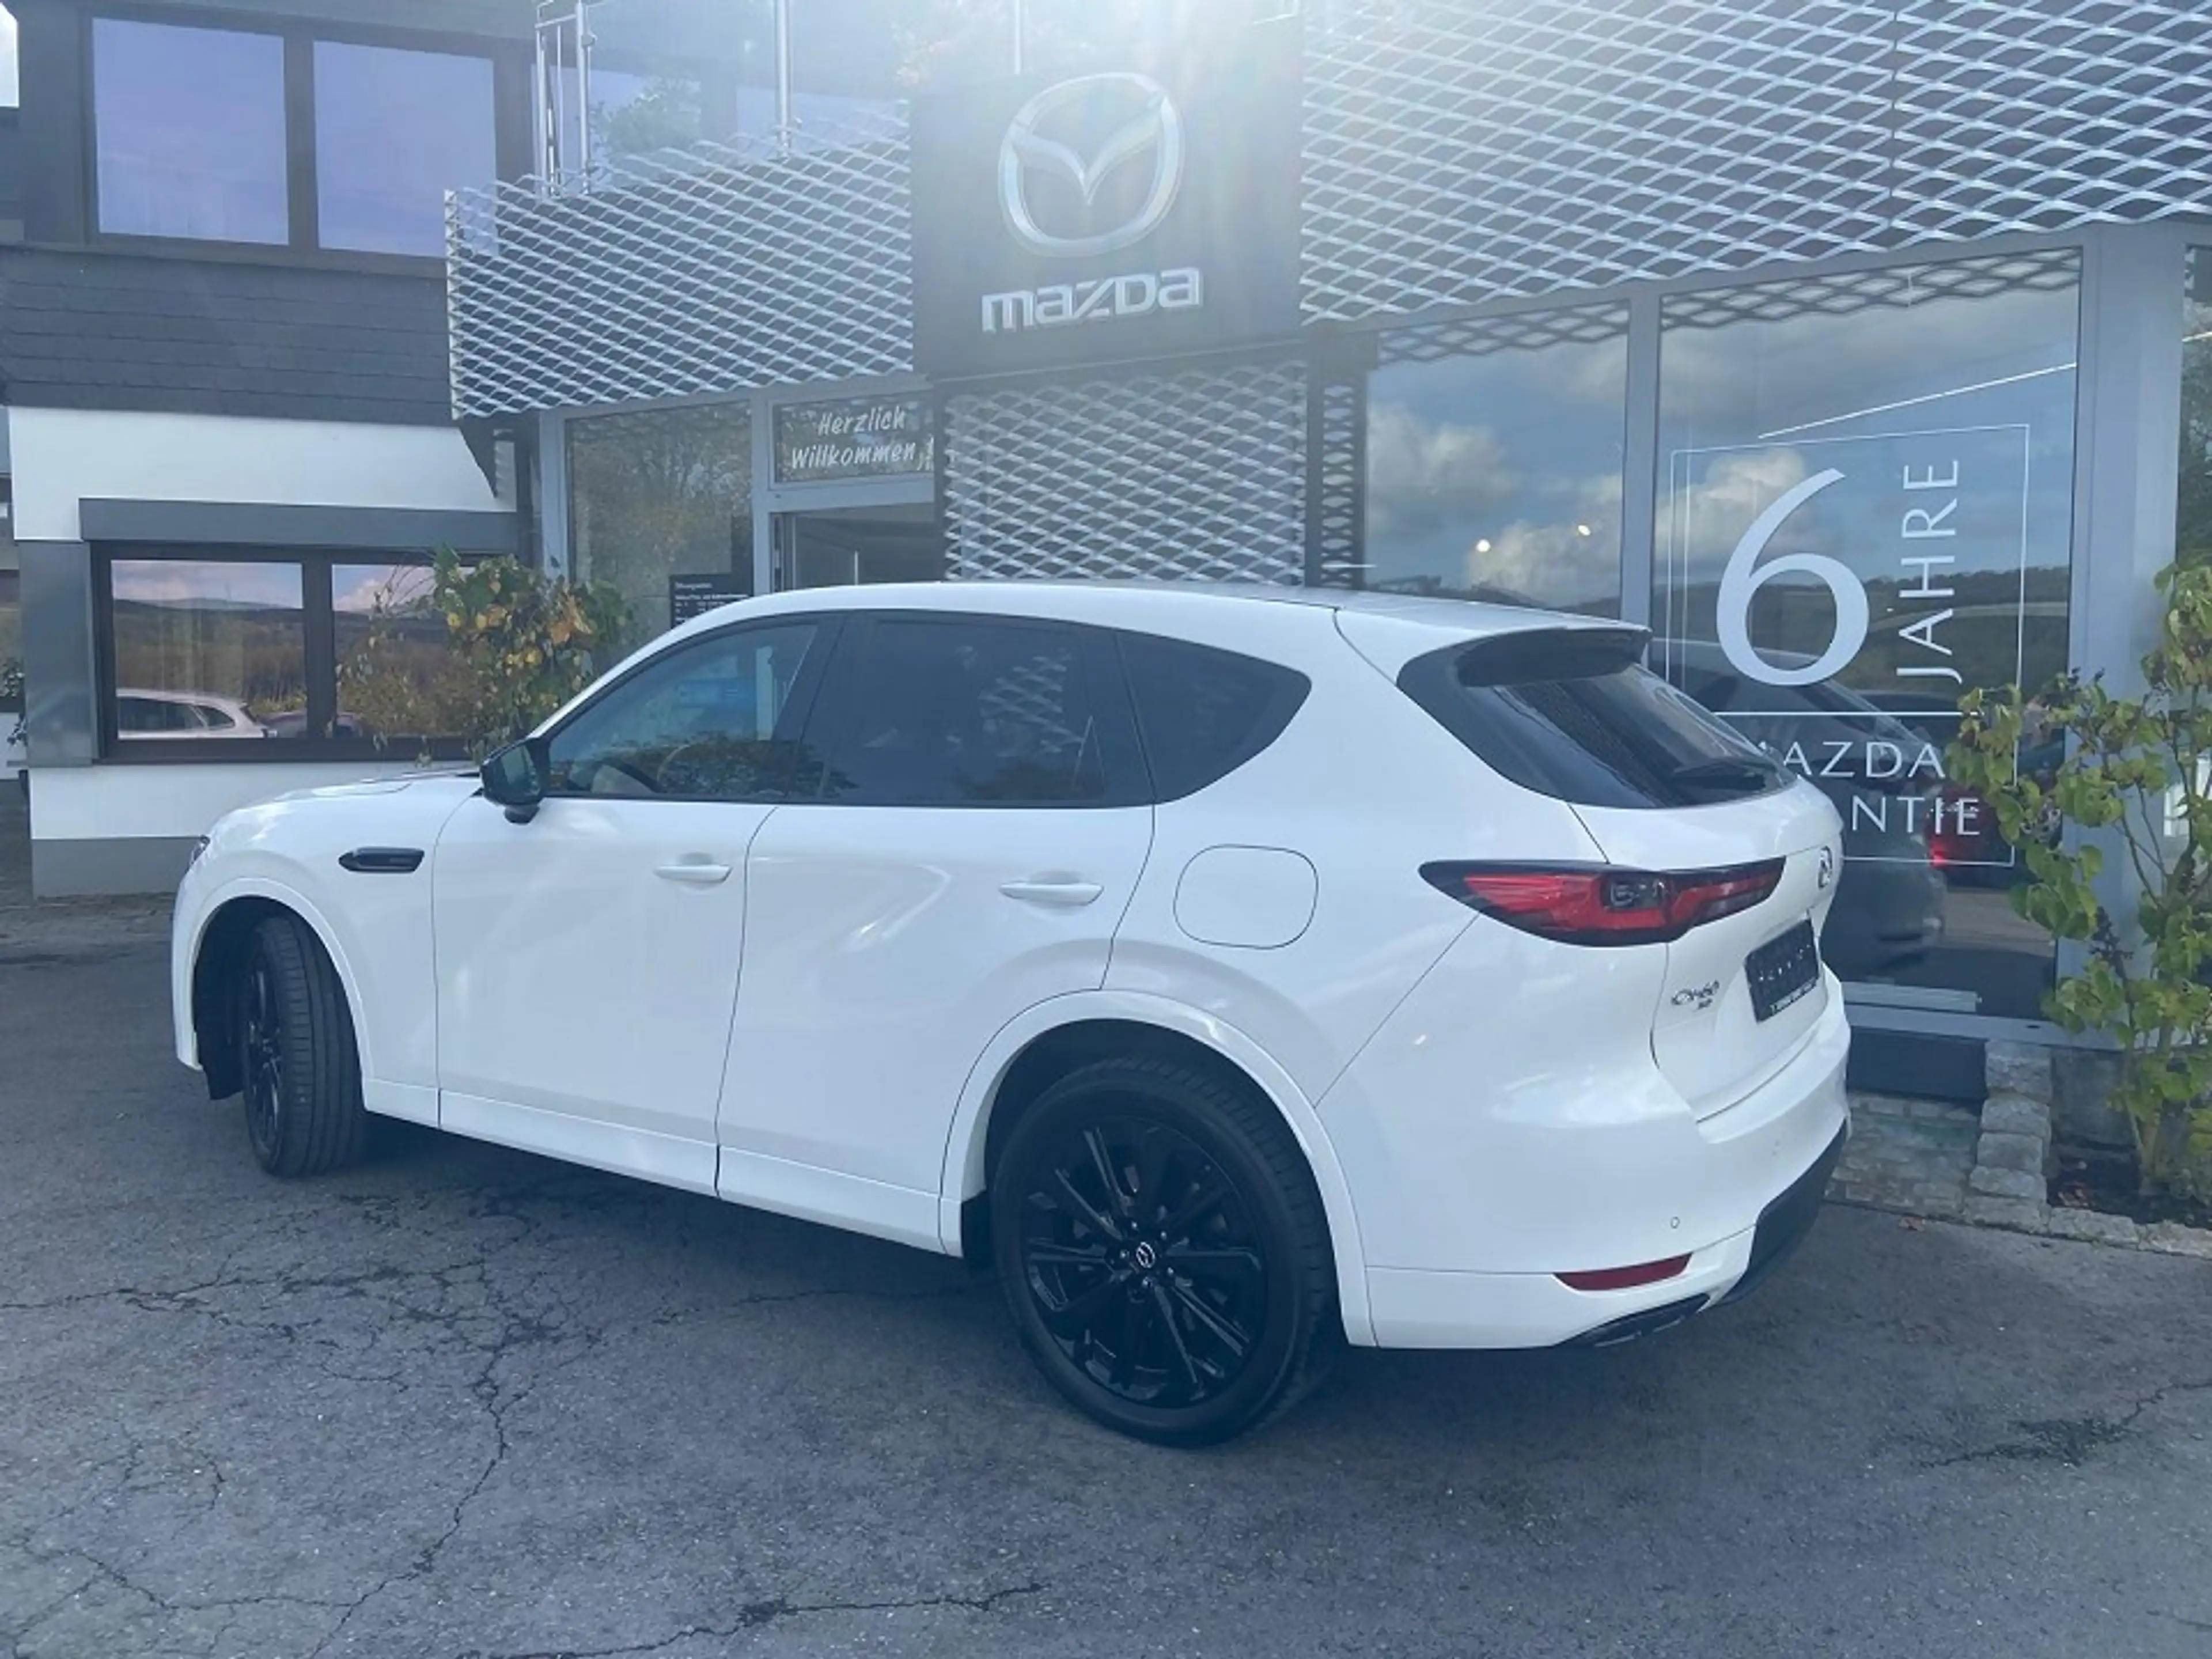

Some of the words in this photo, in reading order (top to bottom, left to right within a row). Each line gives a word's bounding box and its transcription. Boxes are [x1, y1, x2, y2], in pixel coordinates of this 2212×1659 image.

[818, 405, 906, 435] Herzlich
[791, 442, 916, 469] Willkommen
[1716, 467, 1870, 685] 6
[1896, 459, 1963, 684] JAHRE
[1759, 741, 1946, 778] AZDA
[1852, 795, 1980, 836] NTIE
